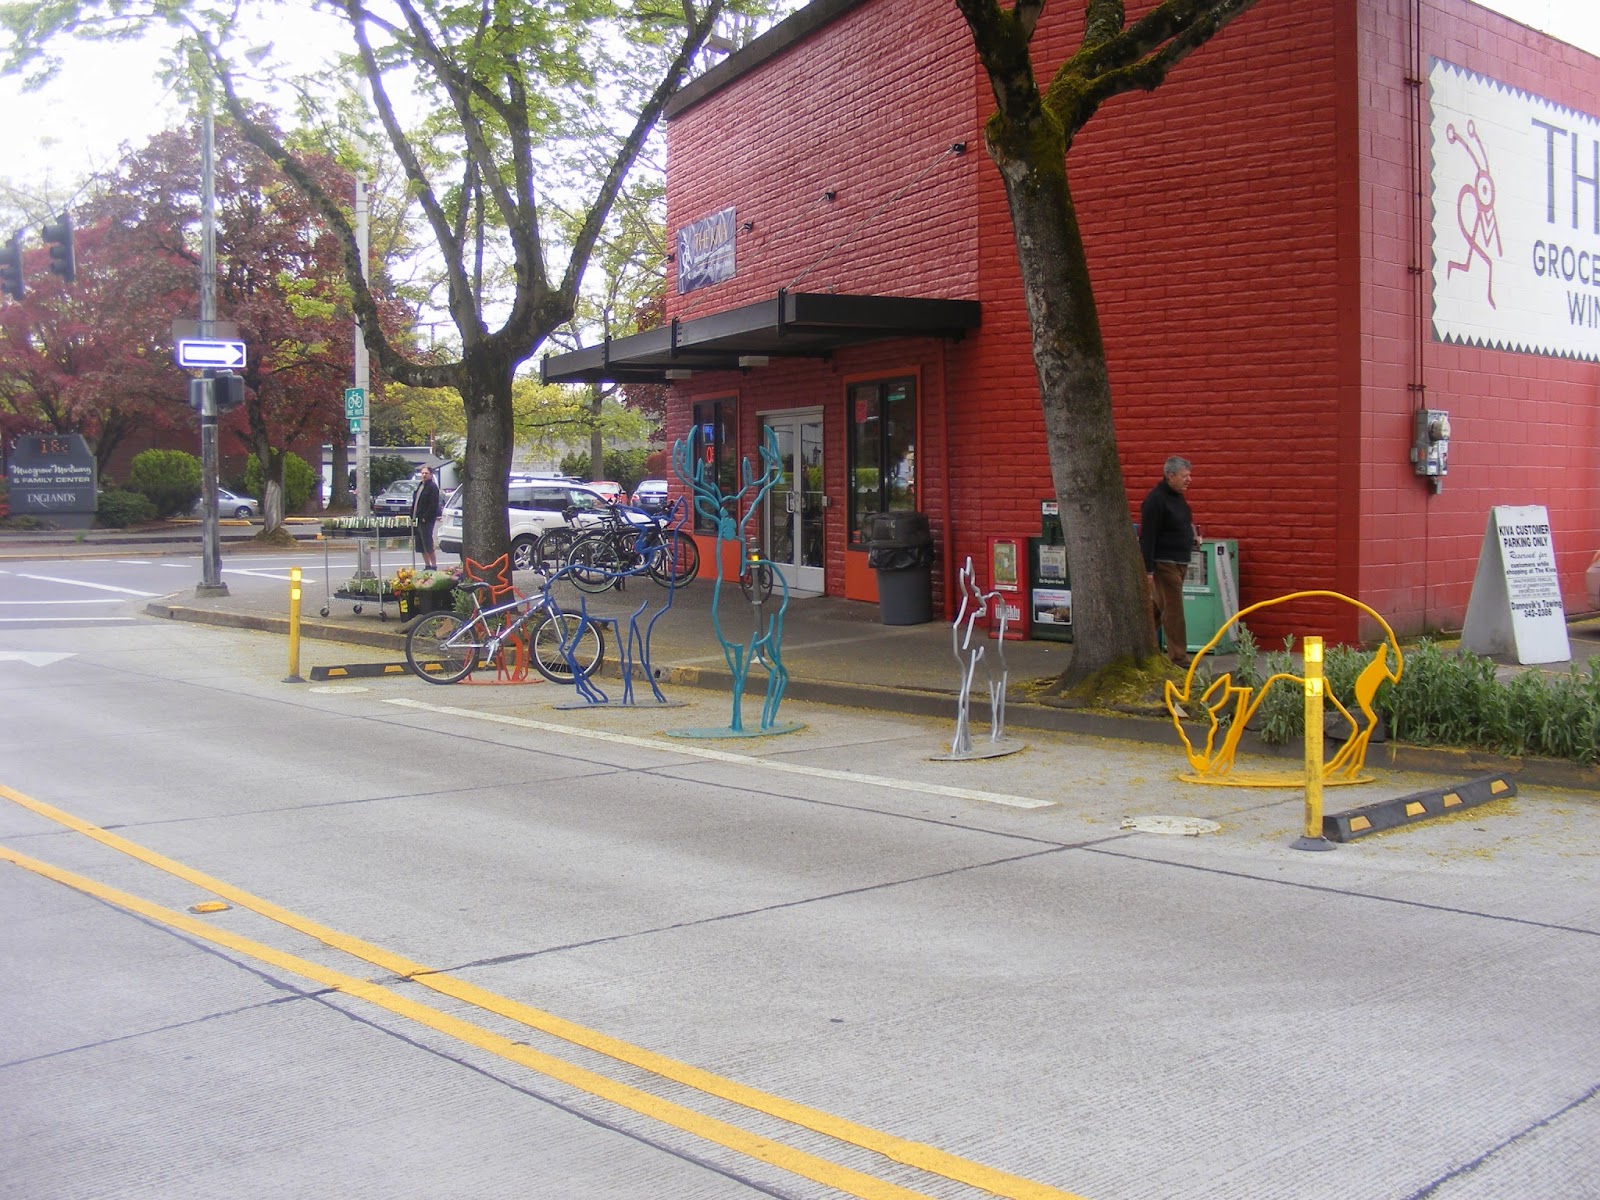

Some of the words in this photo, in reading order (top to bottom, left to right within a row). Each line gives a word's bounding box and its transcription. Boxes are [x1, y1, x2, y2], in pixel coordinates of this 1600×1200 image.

[1531, 117, 1600, 235] TH
[1533, 239, 1600, 288] GROCE
[51, 464, 91, 475] Mortuary
[1499, 525, 1514, 536] KIVA
[1516, 524, 1549, 535] CUSTOMER
[1503, 537, 1531, 548] PARKING
[1533, 536, 1548, 547] ONLY
[1542, 600, 1562, 608] Towing
